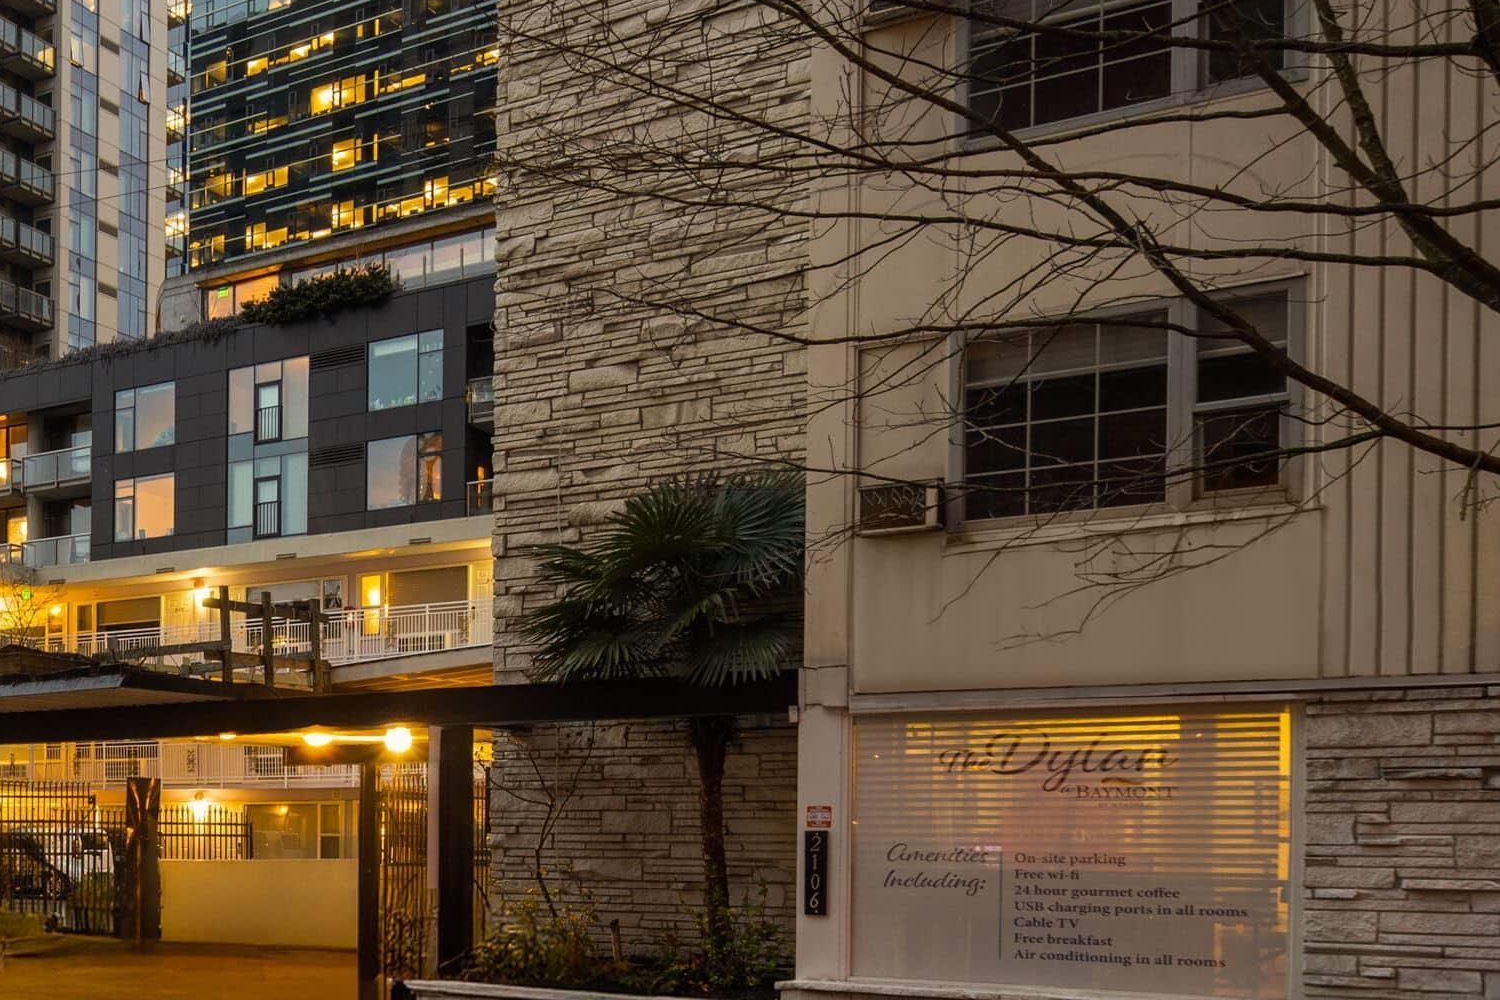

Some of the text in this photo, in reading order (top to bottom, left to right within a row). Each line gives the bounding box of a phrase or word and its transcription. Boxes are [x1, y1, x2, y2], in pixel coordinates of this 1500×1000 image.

[939, 733, 1179, 792] The Dylan
[1076, 785, 1175, 799] BAYMONT
[886, 843, 989, 863] Amenities
[1014, 852, 1126, 867] On-site parking
[809, 835, 822, 909] 2106
[1014, 869, 1080, 880] Free wi-fi
[884, 870, 986, 896] Including:
[1014, 885, 1180, 899] 24 hour gourmet coffee
[1014, 901, 1248, 917] USB charging ports in all rooms
[1014, 917, 1079, 929] Cable TV
[1014, 933, 1112, 946] Free breakfast
[1014, 949, 1226, 967] Air conditioning in all rooms
